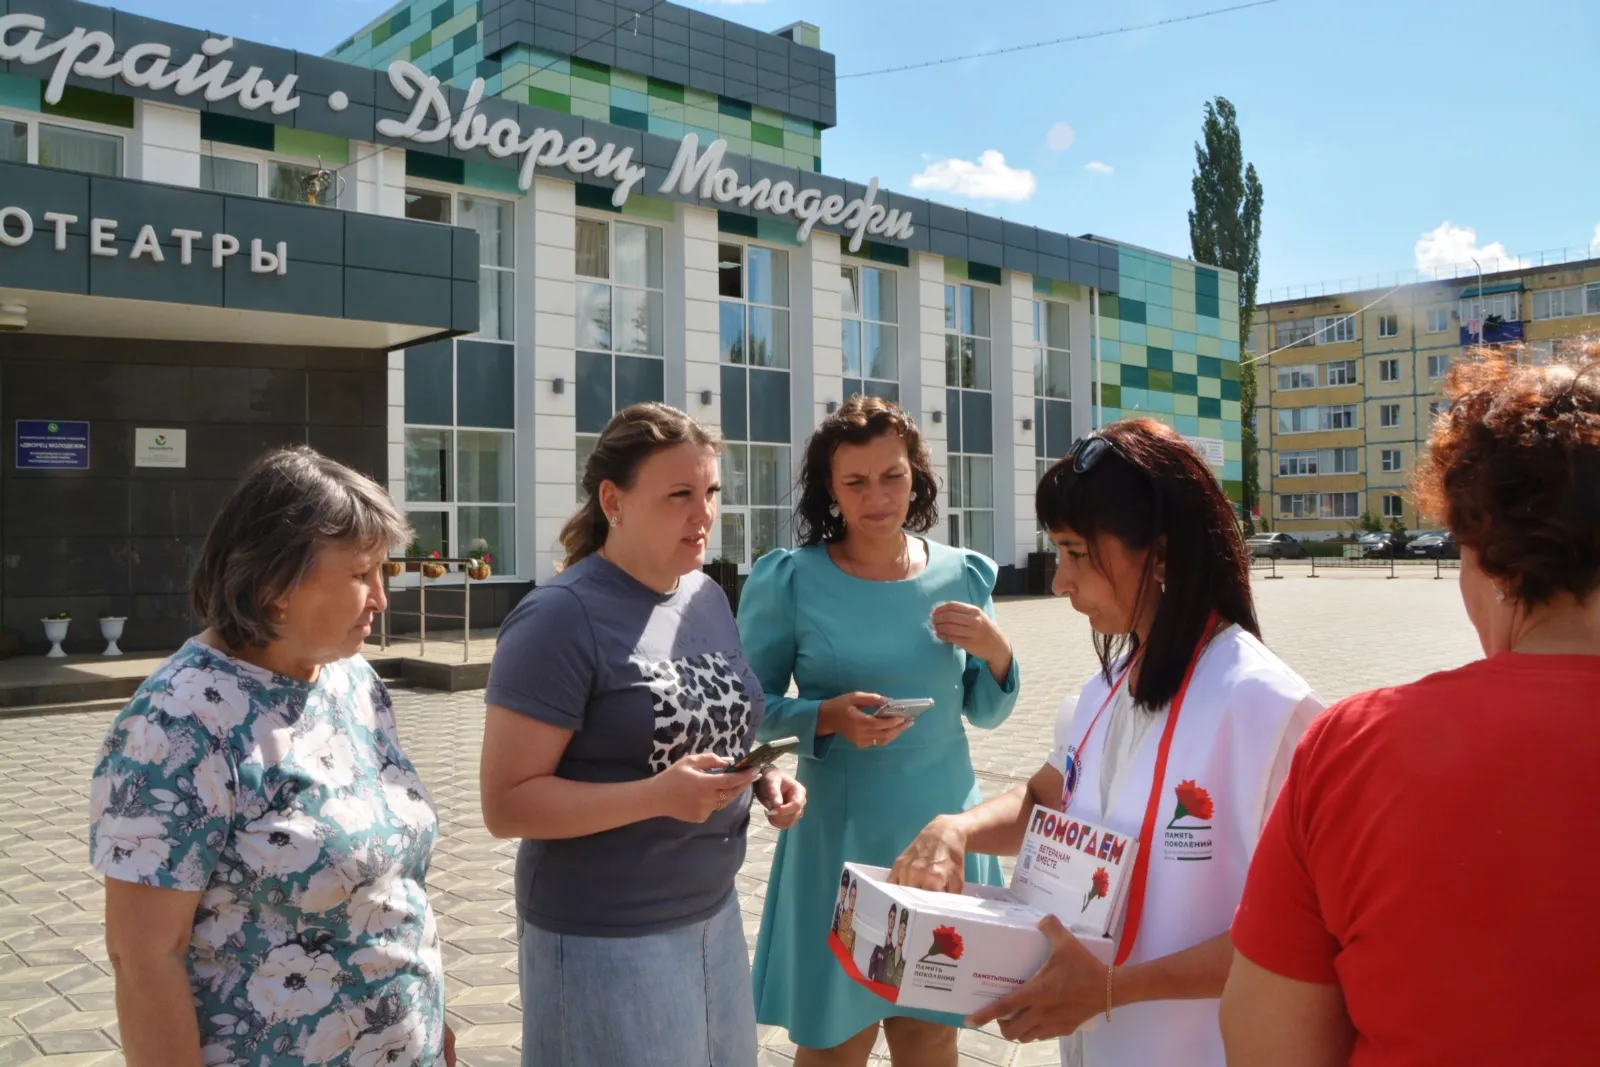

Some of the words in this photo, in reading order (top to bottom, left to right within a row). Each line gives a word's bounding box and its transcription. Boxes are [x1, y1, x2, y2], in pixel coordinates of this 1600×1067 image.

[376, 60, 646, 207] Дворец
[658, 132, 914, 253] Молодежи
[0, 206, 287, 275] ОТЕАТРЫ
[1030, 809, 1127, 866] ПОМОГАЕМ
[1164, 840, 1213, 848] ПОКОЛЕНИЙ
[1036, 853, 1058, 869] ВМЕСТЕ
[1038, 843, 1071, 863] ВЕТЕРАНАМ
[913, 970, 956, 982] ПОКОЛЕНИЙ
[915, 964, 943, 973] ПАМЯТЬ
